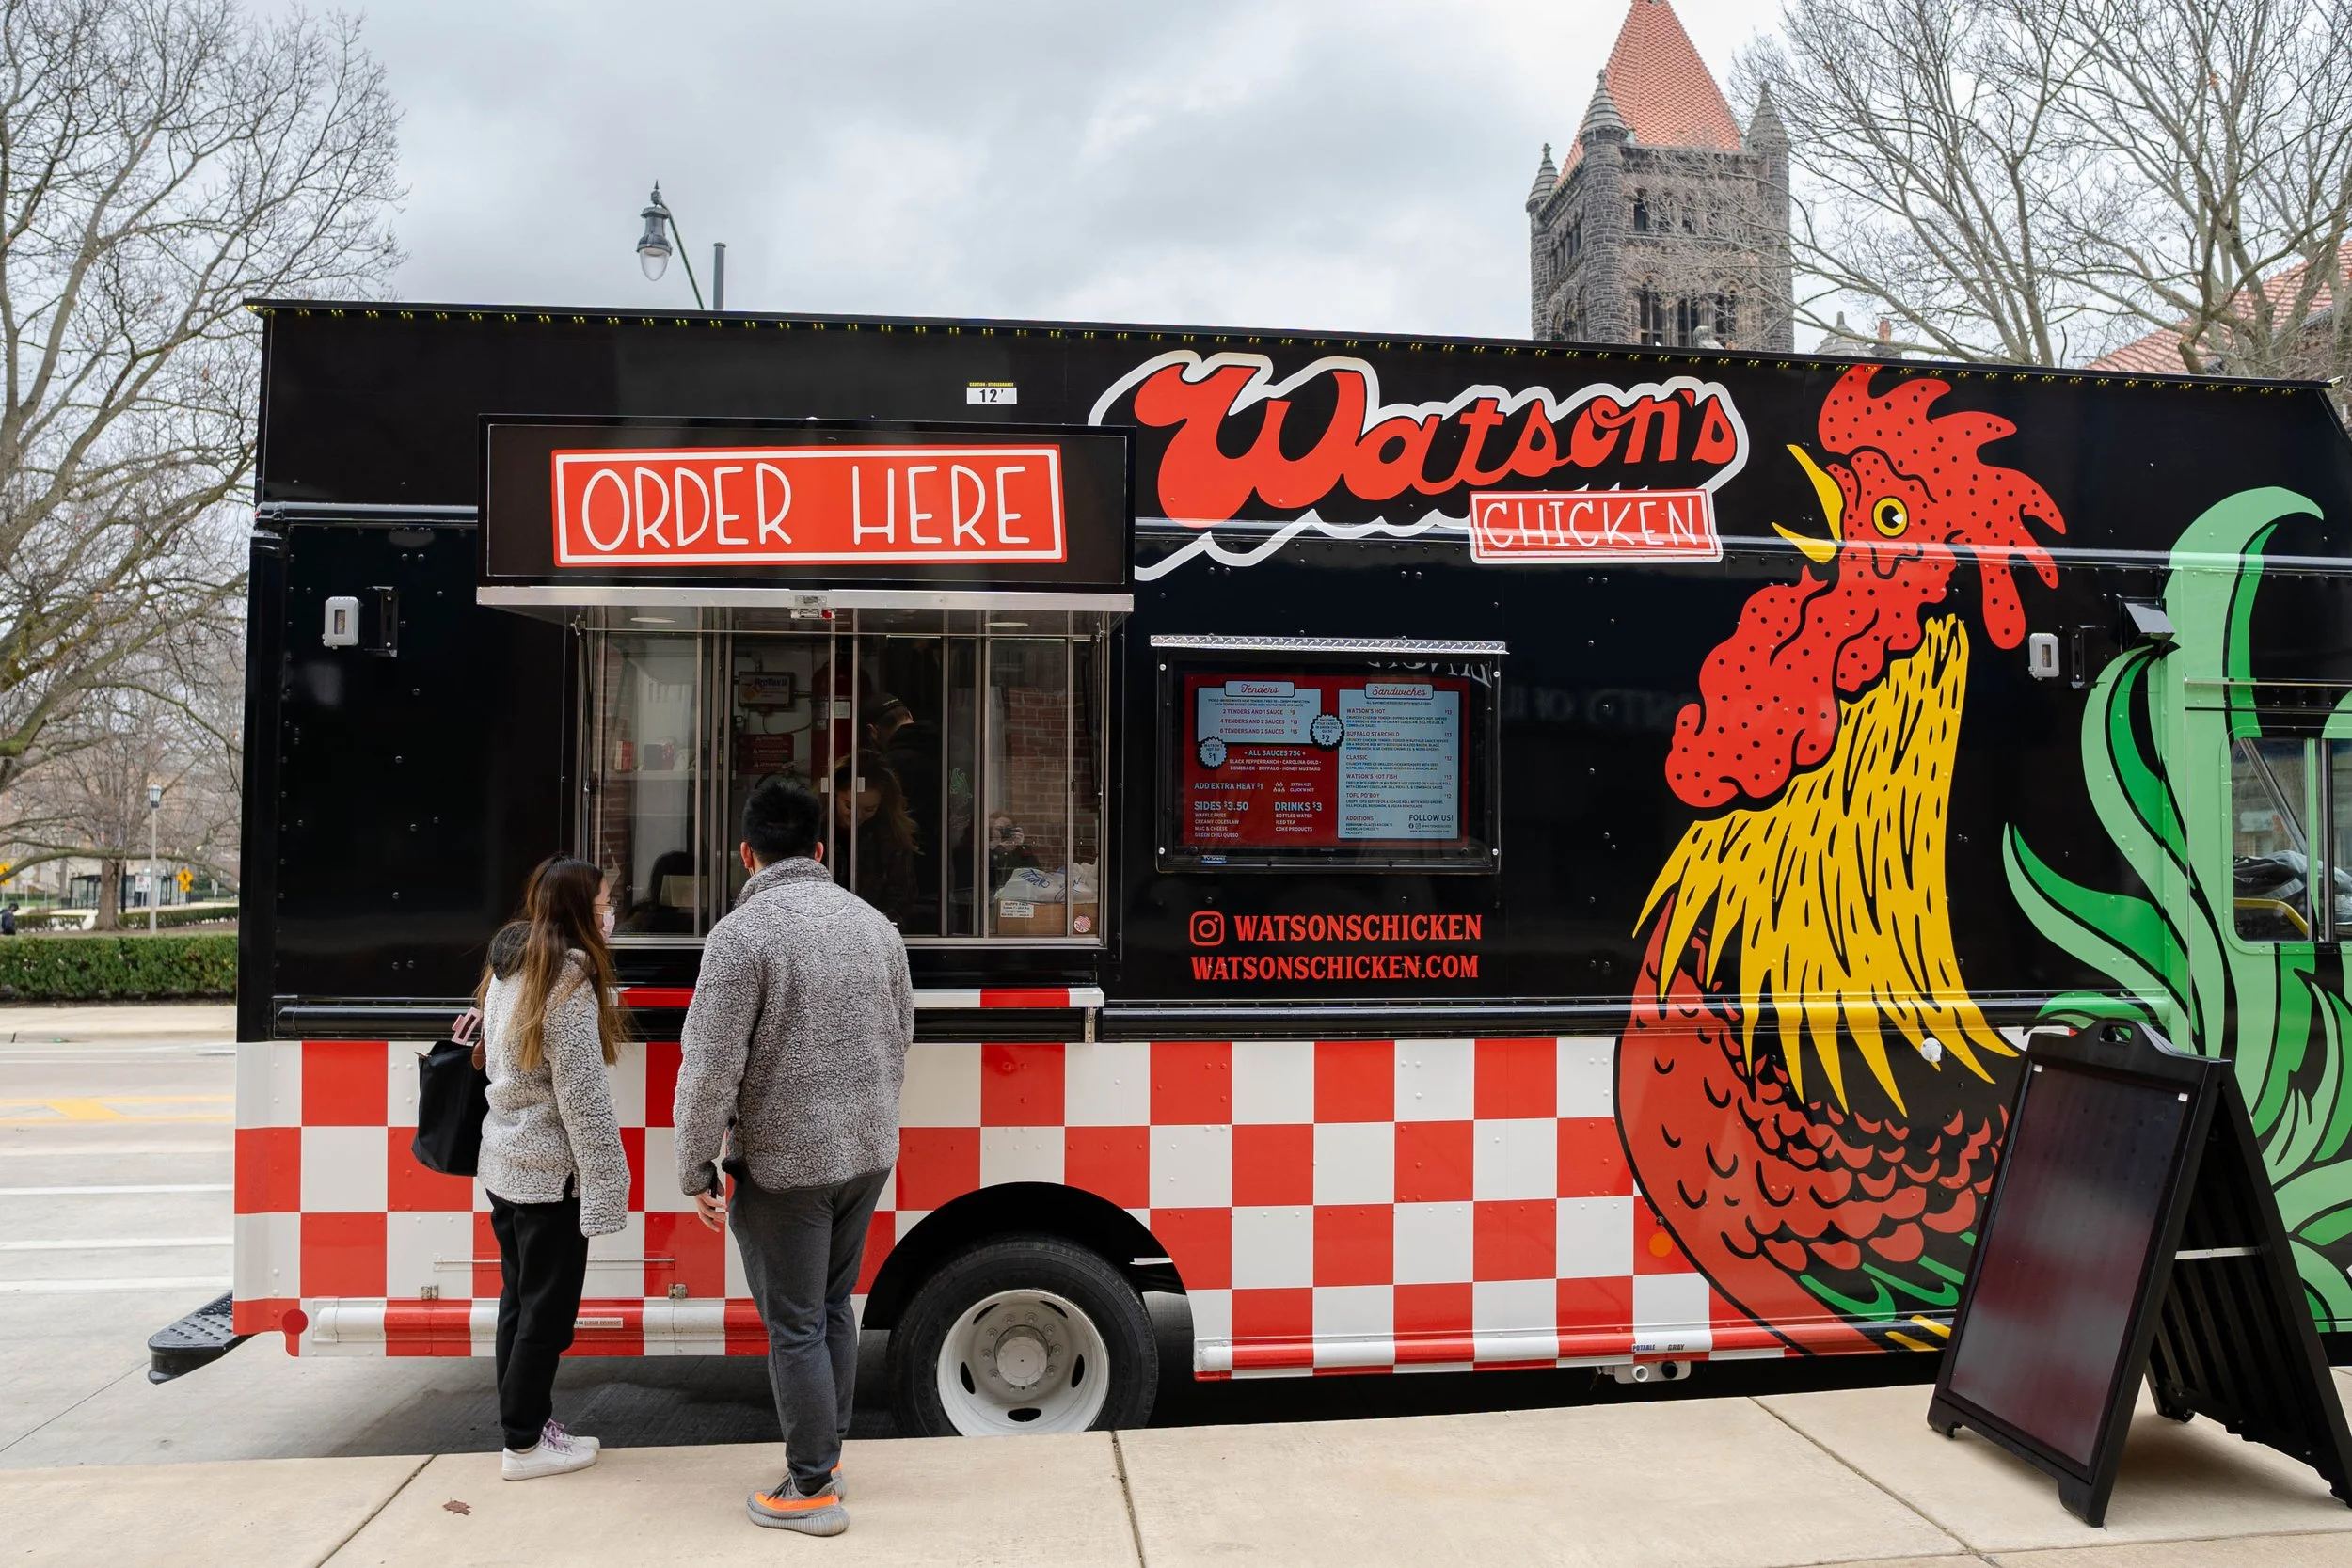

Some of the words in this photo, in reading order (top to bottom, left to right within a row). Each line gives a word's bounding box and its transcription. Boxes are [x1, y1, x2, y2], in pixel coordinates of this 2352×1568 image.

[979, 388, 1004, 403] 12'
[1134, 363, 1738, 529] Watson's
[581, 462, 792, 551] ORDER
[852, 463, 1030, 546] HERE
[1481, 496, 1701, 548] CHICKEN
[1241, 683, 1279, 694] Tenders
[1372, 686, 1427, 696] Sandwiches
[1321, 734, 1330, 743] $2
[1208, 752, 1216, 762] $1
[1194, 801, 1222, 811] SIDES
[1223, 800, 1248, 811] $3.50
[1274, 801, 1311, 811] DRINKS
[1312, 801, 1323, 812] $3
[1408, 814, 1439, 822] FOLLOW
[1234, 913, 1483, 942] WATSONSCHICKEN
[1190, 954, 1479, 980] WATSONSCHICKEN.COM
